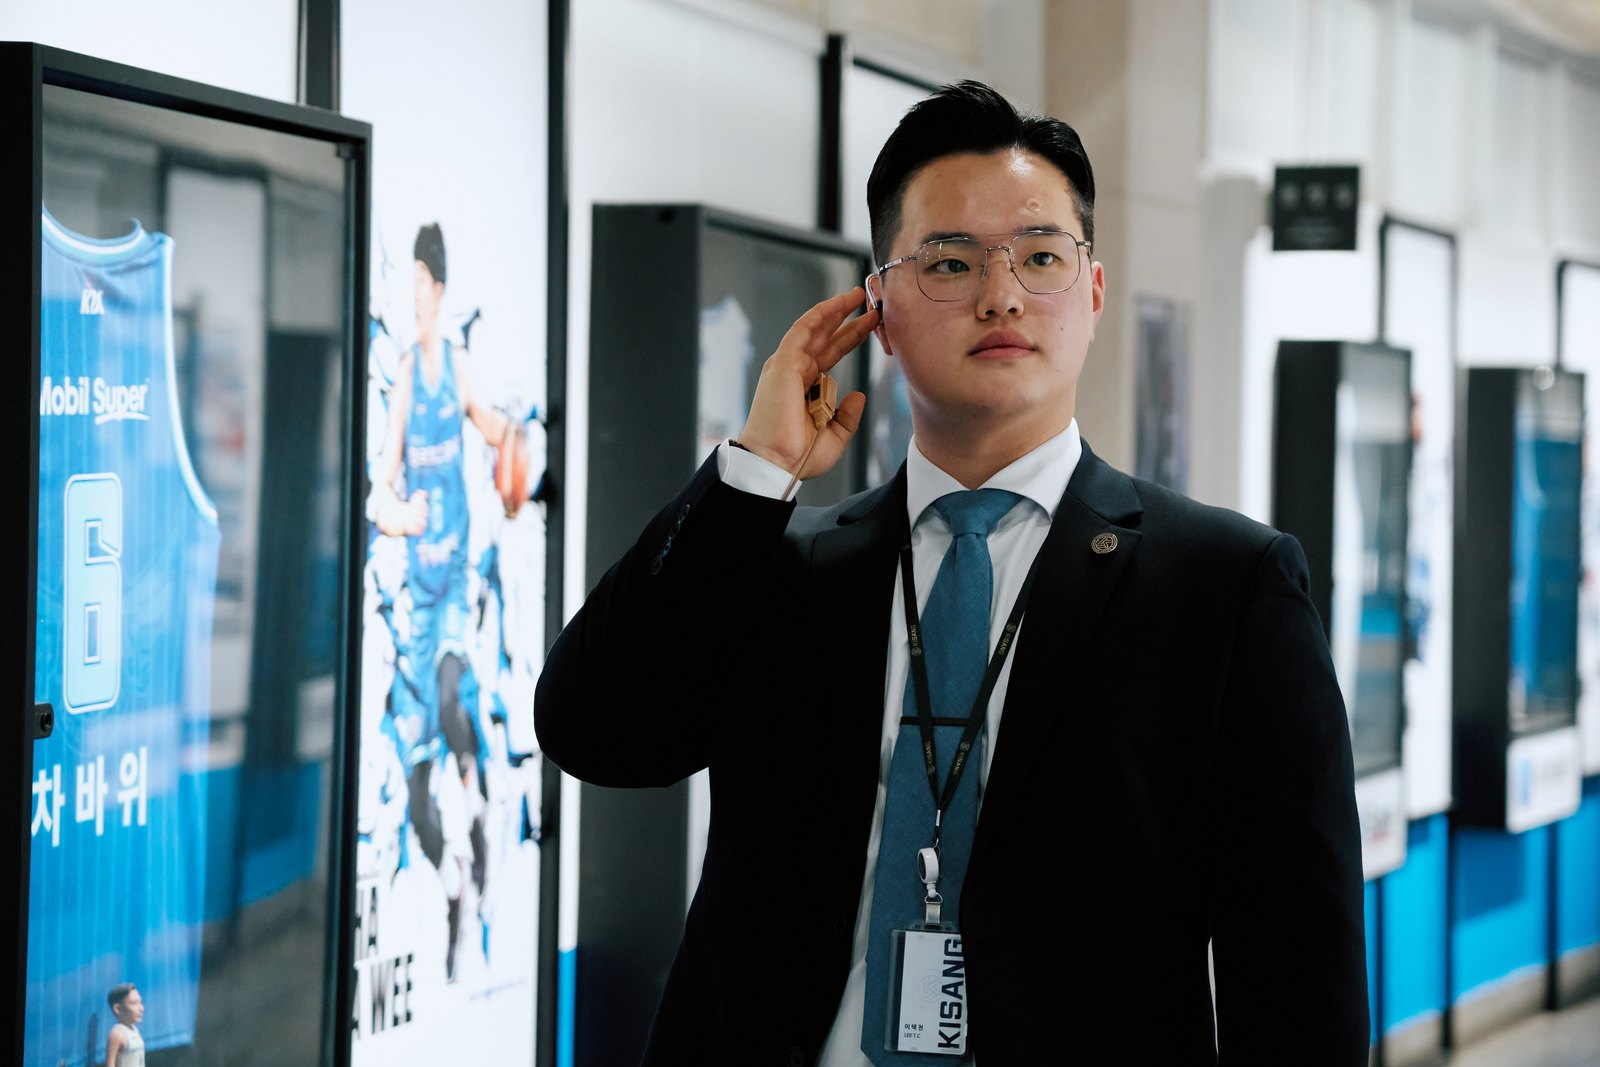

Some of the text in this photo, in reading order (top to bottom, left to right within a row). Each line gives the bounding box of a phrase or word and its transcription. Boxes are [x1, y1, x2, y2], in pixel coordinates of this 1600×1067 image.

[93, 377, 148, 421] Super
[63, 472, 122, 714] 6
[370, 953, 413, 1035] WEE
[937, 939, 965, 1050] KISANG
